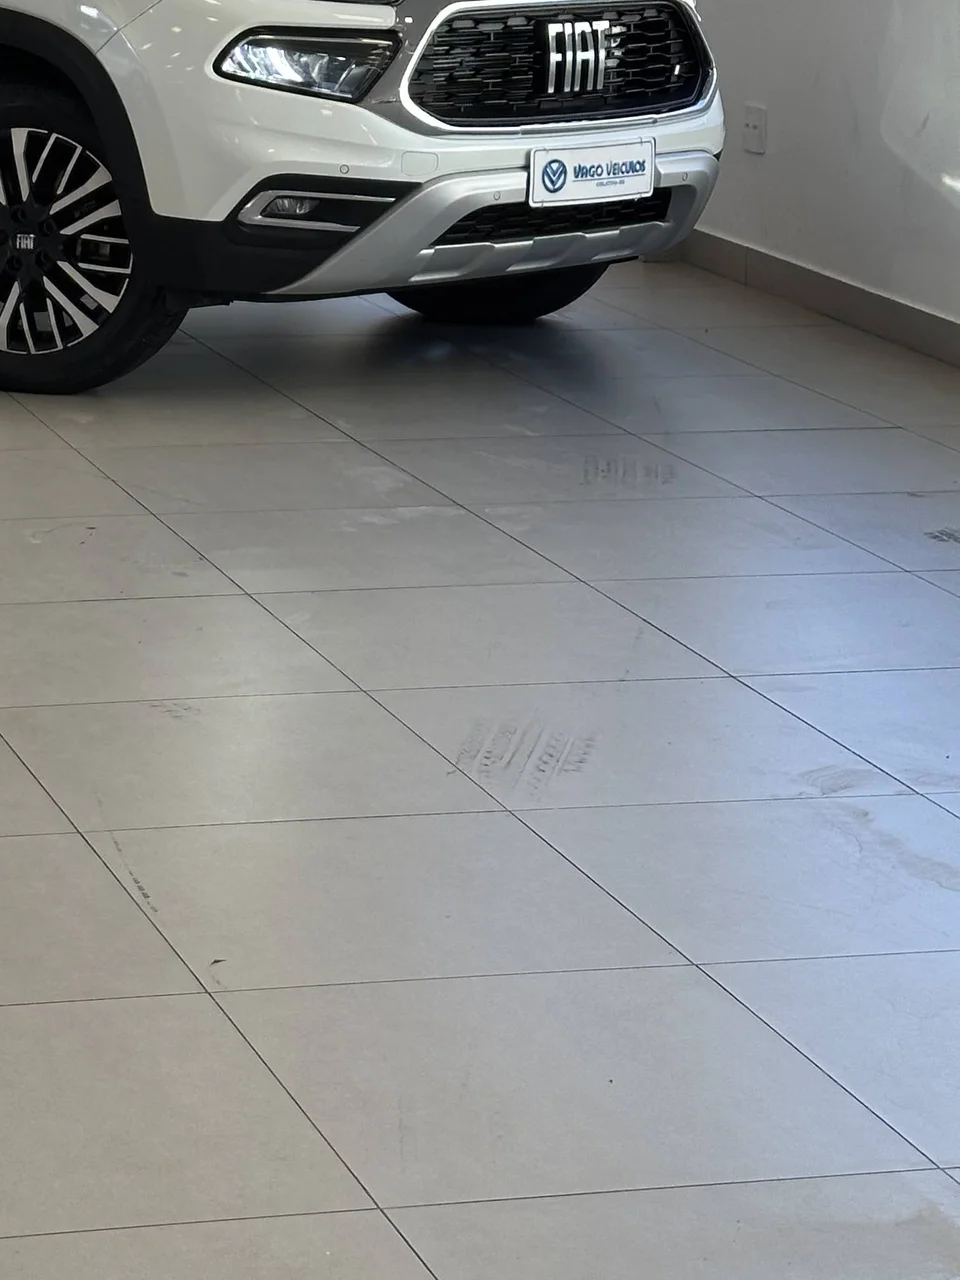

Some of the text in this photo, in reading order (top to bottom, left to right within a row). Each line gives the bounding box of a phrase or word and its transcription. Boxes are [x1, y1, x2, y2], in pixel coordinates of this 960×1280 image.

[547, 20, 610, 93] FIAT
[573, 163, 603, 179] VAGO
[16, 234, 35, 249] FIAT
